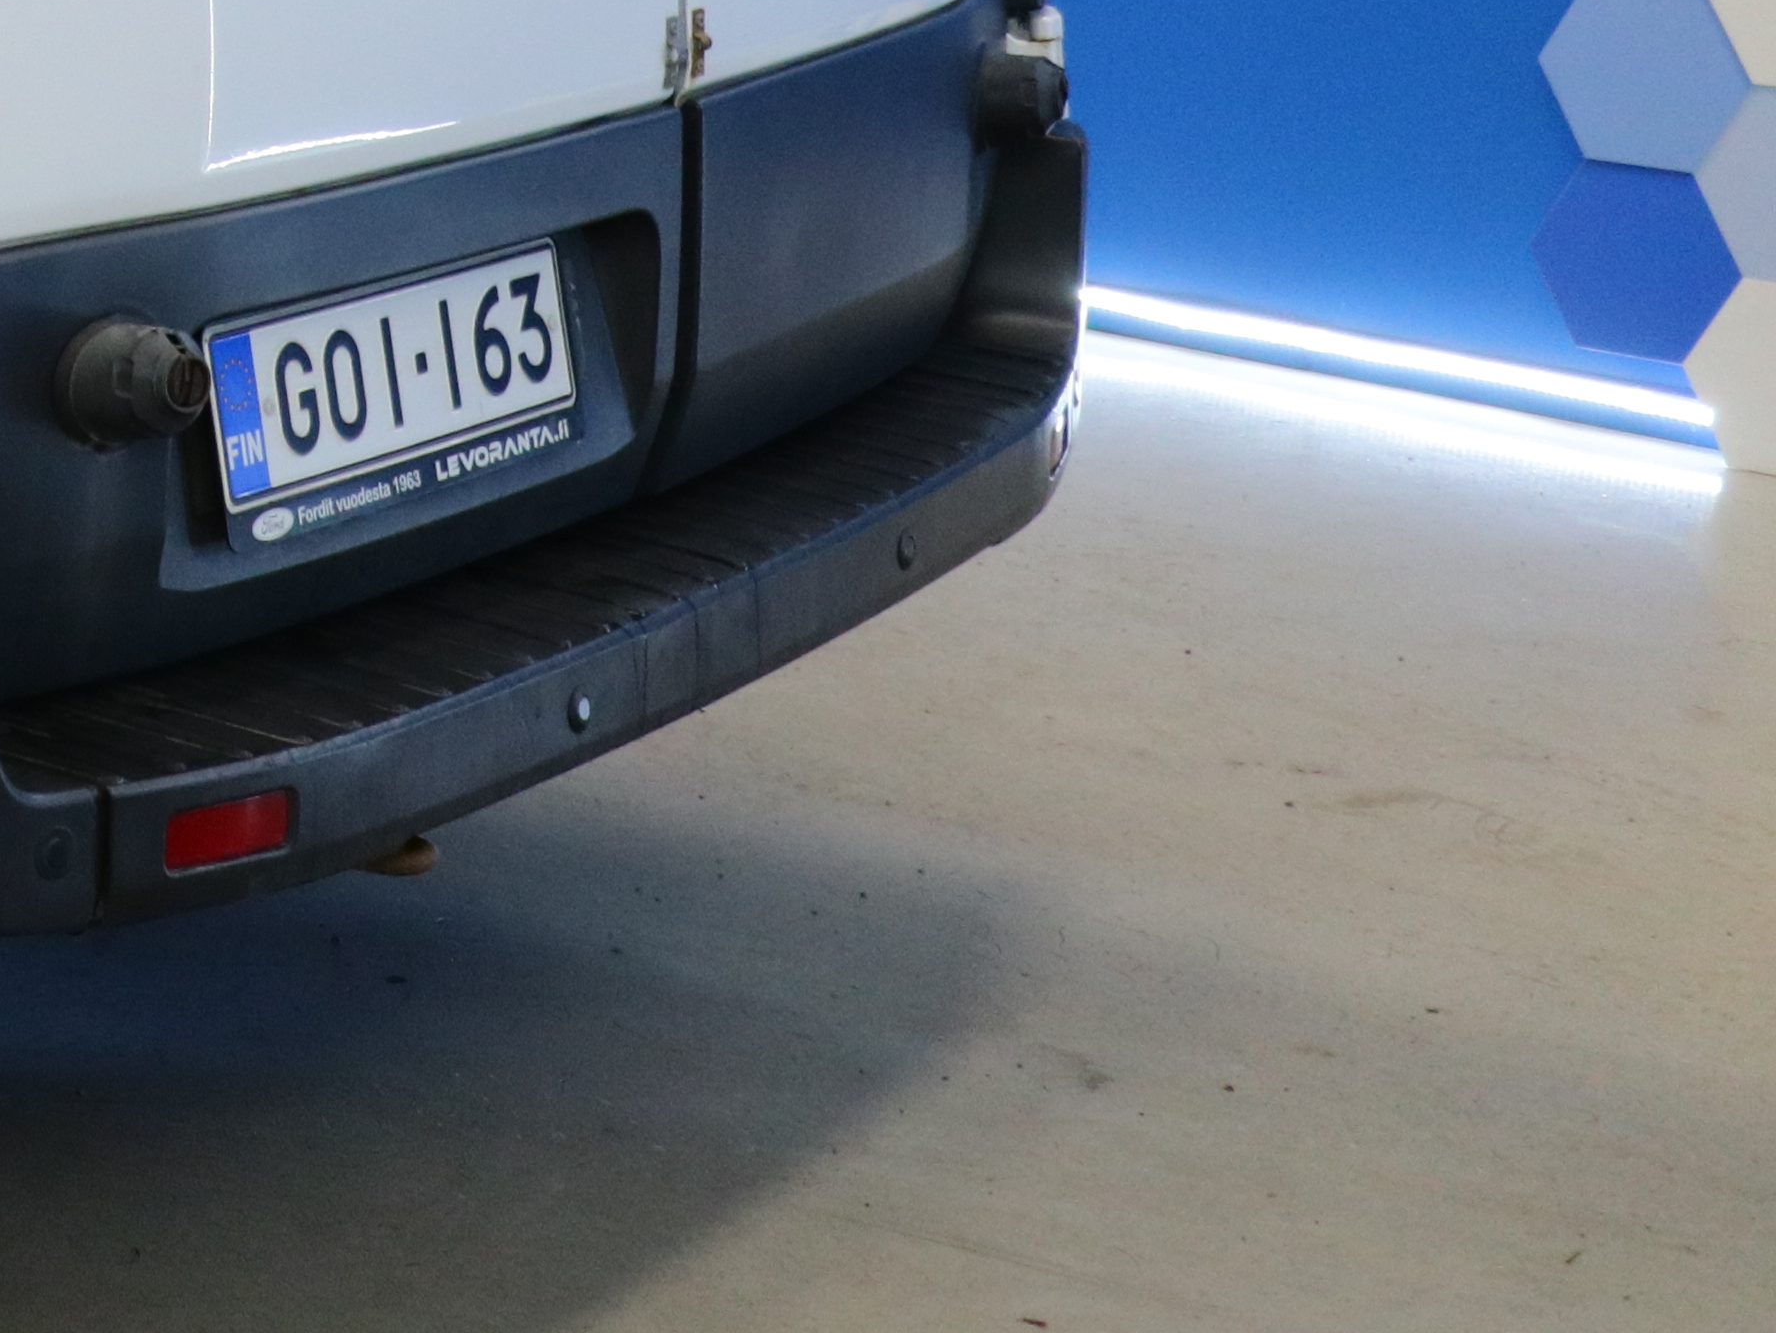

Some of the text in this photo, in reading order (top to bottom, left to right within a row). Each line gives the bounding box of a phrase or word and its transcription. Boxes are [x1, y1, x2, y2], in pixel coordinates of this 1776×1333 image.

[226, 432, 265, 471] FIN
[297, 418, 570, 527] Fordit vuodesta 1963 LEVORANTA.fi
